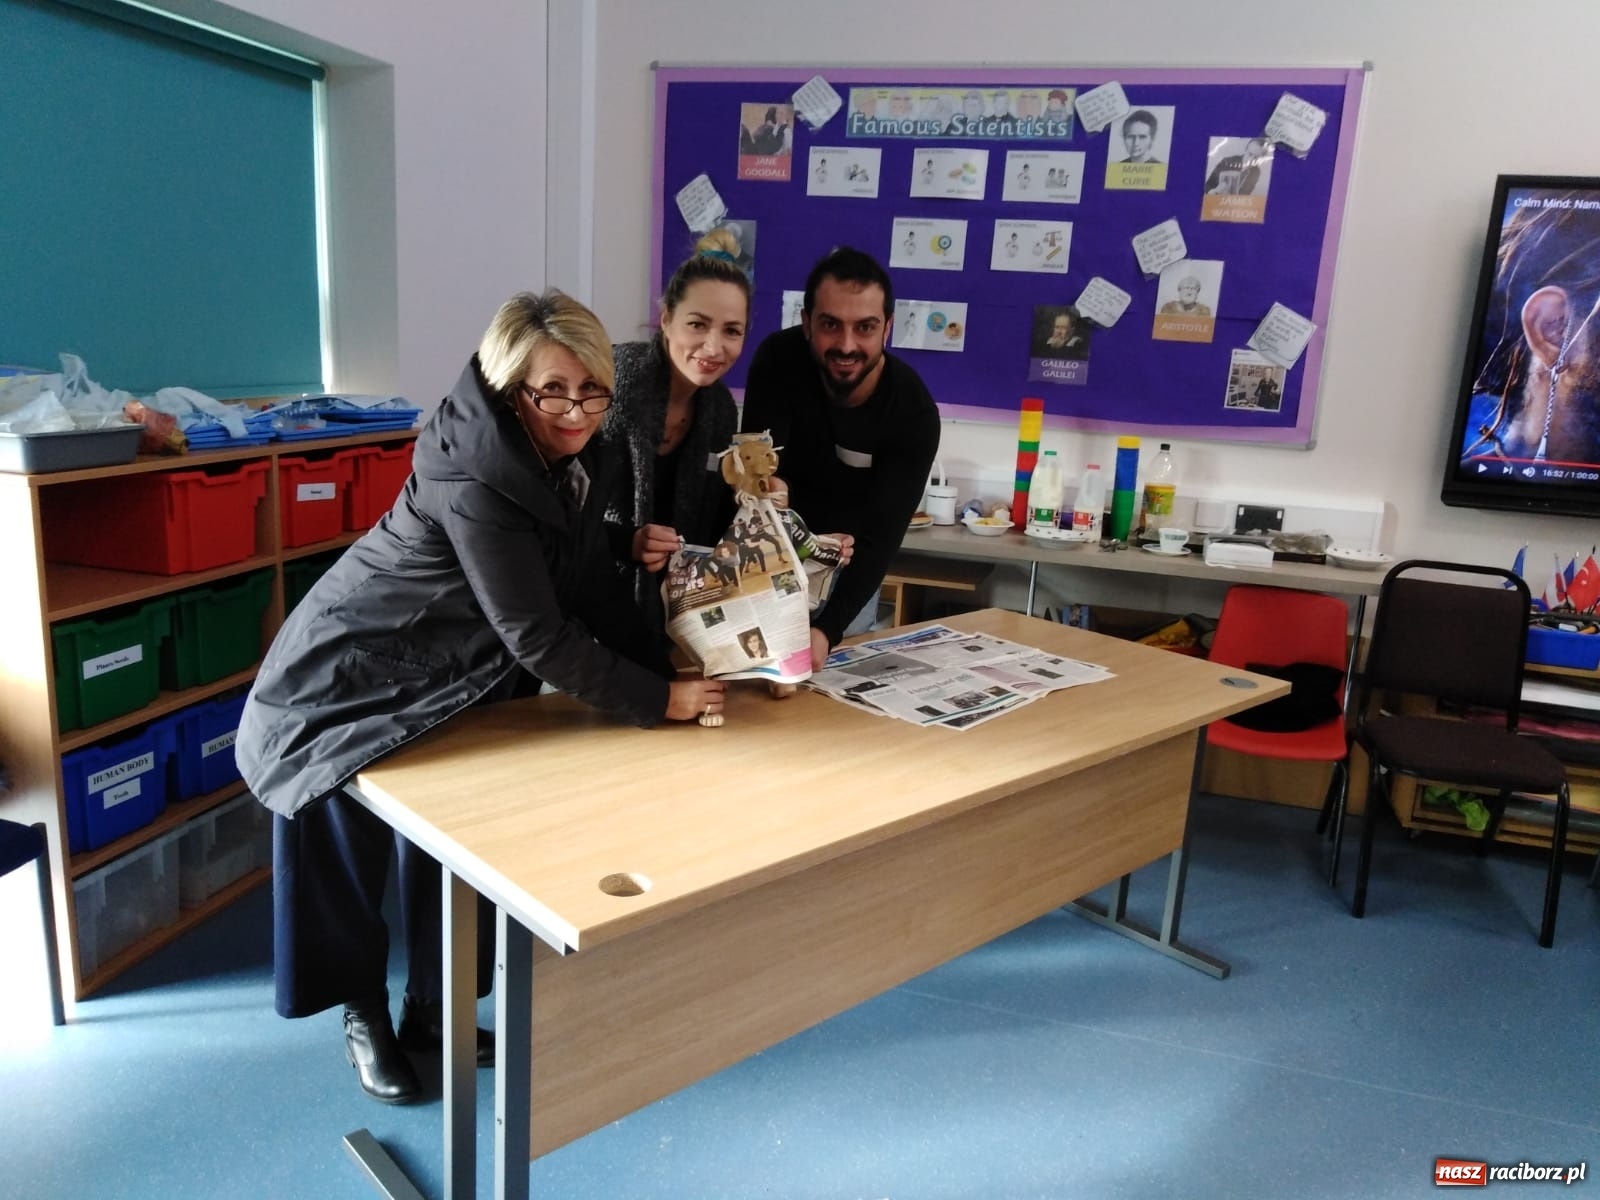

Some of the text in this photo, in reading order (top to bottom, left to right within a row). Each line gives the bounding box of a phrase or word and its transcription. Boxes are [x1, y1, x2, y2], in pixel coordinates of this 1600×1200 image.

[852, 113, 1068, 136] Famous Scientists
[755, 157, 777, 166] JANE
[744, 167, 787, 177] GOODALL
[1122, 165, 1153, 174] MARIE
[1121, 177, 1150, 186] CURIE
[1220, 196, 1253, 206] JAMES
[1514, 198, 1541, 208] Calm
[1543, 198, 1572, 209] Mind:
[1211, 208, 1258, 218] WATSON
[1041, 359, 1079, 369] GALILEO
[1042, 370, 1076, 379] GALILEI
[1543, 469, 1563, 478] 16:52
[1571, 471, 1599, 480] 1:00:00
[209, 736, 234, 753] HUMAN
[93, 756, 149, 785] HUMAN BODY
